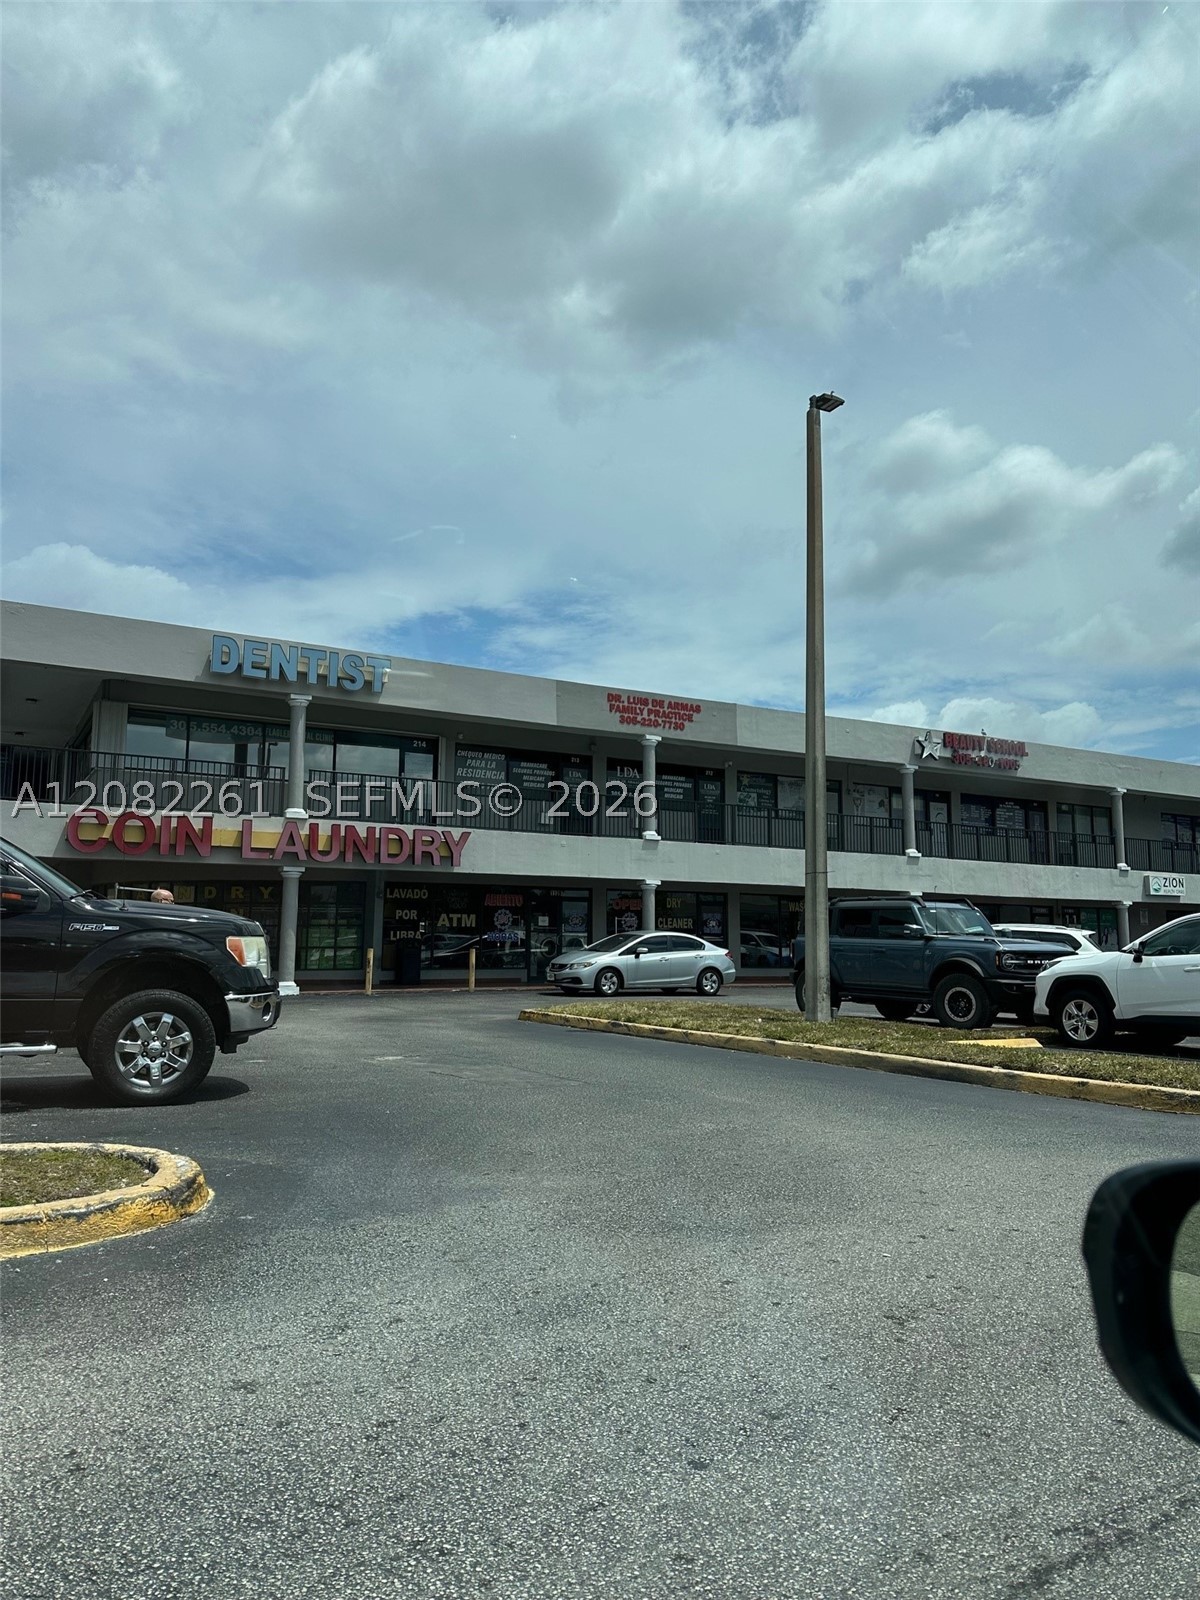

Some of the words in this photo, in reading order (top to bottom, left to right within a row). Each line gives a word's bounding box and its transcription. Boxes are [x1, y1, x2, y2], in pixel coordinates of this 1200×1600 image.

[210, 634, 391, 694] DENTIST
[606, 692, 625, 704] DR.
[627, 695, 650, 707] LUIS
[652, 698, 665, 709] DE
[666, 700, 702, 714] ARMAS
[608, 703, 645, 717] FAMILY
[647, 708, 694, 723] PRACTICE
[412, 740, 427, 748] 214
[942, 731, 985, 752] BEAUTY
[987, 737, 1029, 757] SCHOOL
[466, 759, 485, 768] PARA
[487, 761, 496, 769] LA
[456, 768, 506, 780] RESIDENCIA
[616, 765, 640, 779] LDA
[66, 808, 214, 858] COIN
[241, 818, 472, 868] LAUNDRY
[1162, 876, 1185, 888] ZION
[666, 897, 682, 909] DRY
[395, 908, 418, 920] POR
[436, 912, 477, 928] ATM
[657, 917, 694, 929] CLEANER
[389, 929, 422, 942] LIBRA
[486, 931, 520, 942] HORAS
